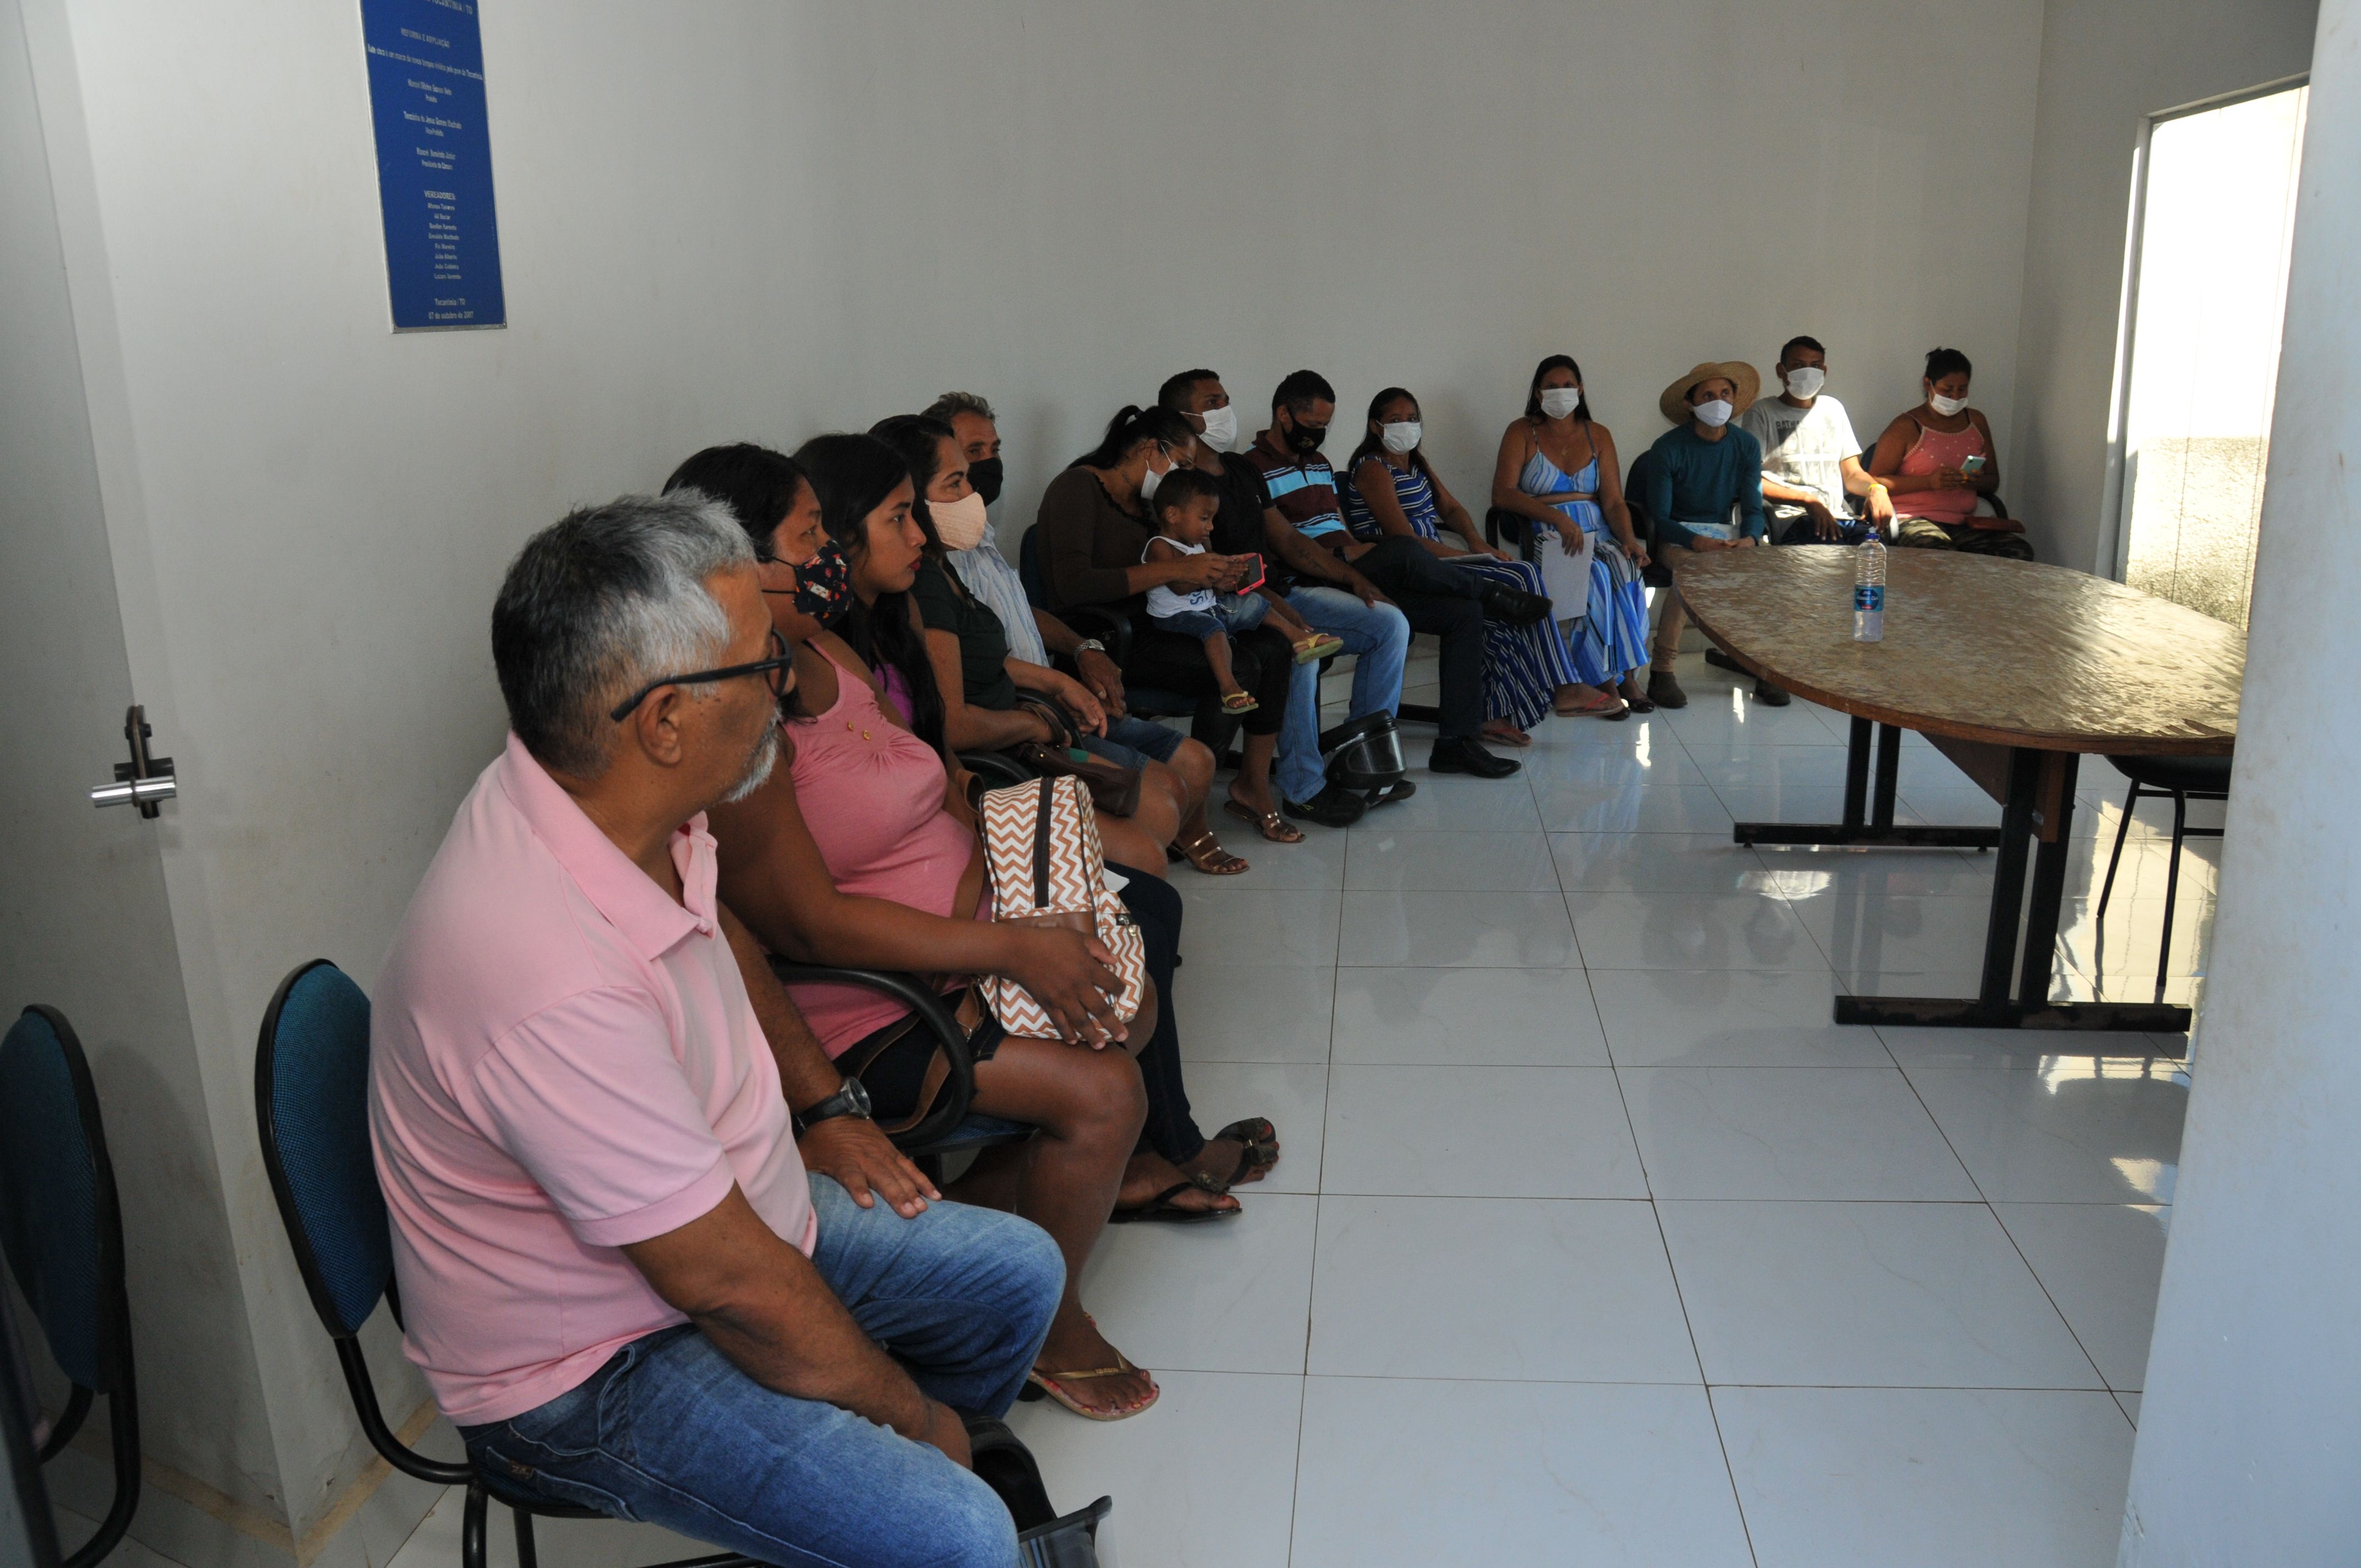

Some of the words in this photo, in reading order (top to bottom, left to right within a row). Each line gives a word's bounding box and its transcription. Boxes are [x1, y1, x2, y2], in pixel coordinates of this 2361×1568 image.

[465, 4, 474, 15] TO
[401, 28, 422, 40] REFORMA
[426, 35, 450, 48] AMPLIAÇÃO
[423, 190, 456, 200] VEREADORES:
